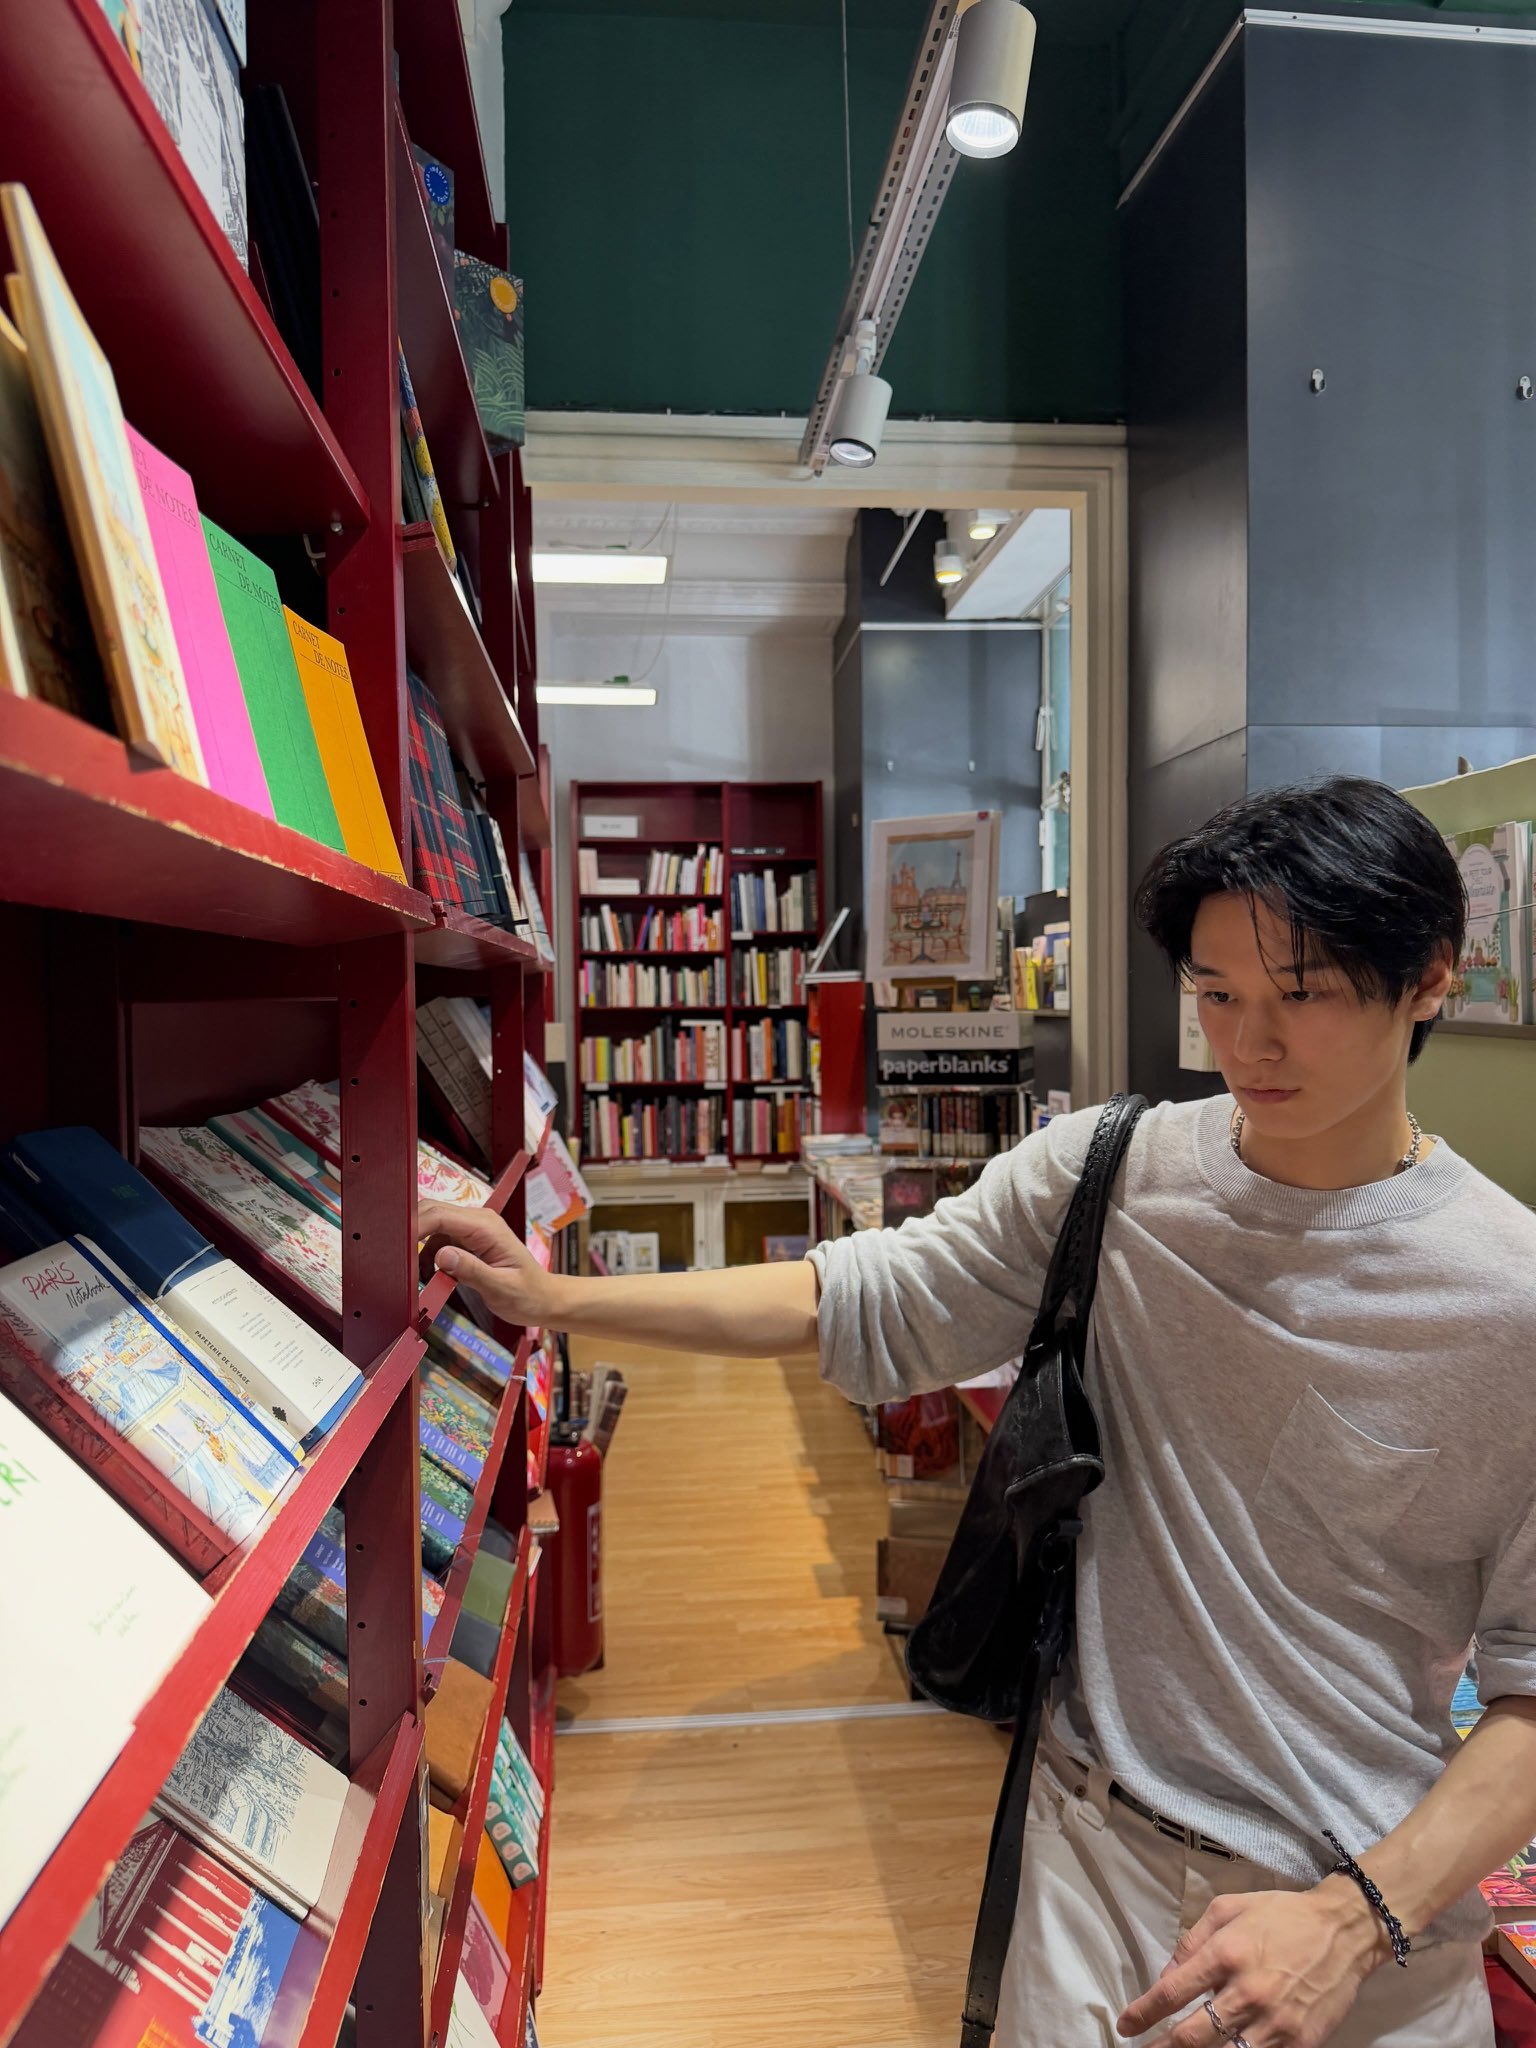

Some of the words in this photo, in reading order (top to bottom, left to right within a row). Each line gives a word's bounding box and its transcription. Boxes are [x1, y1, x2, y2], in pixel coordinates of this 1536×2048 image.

[155, 484, 197, 528] NOTES
[208, 533, 247, 572] CARNET
[238, 571, 253, 594] DE
[252, 581, 281, 614] NOTES
[293, 620, 320, 649] CARNET
[313, 649, 325, 667] DE
[324, 655, 350, 680] NOTES
[891, 1025, 1005, 1039] MOLESKINE
[881, 1055, 1008, 1081] paperblanks
[66, 1274, 111, 1309] Notebook
[194, 1330, 222, 1358] PAPETERIE
[221, 1355, 230, 1365] DE
[229, 1363, 251, 1385] VOYAGE
